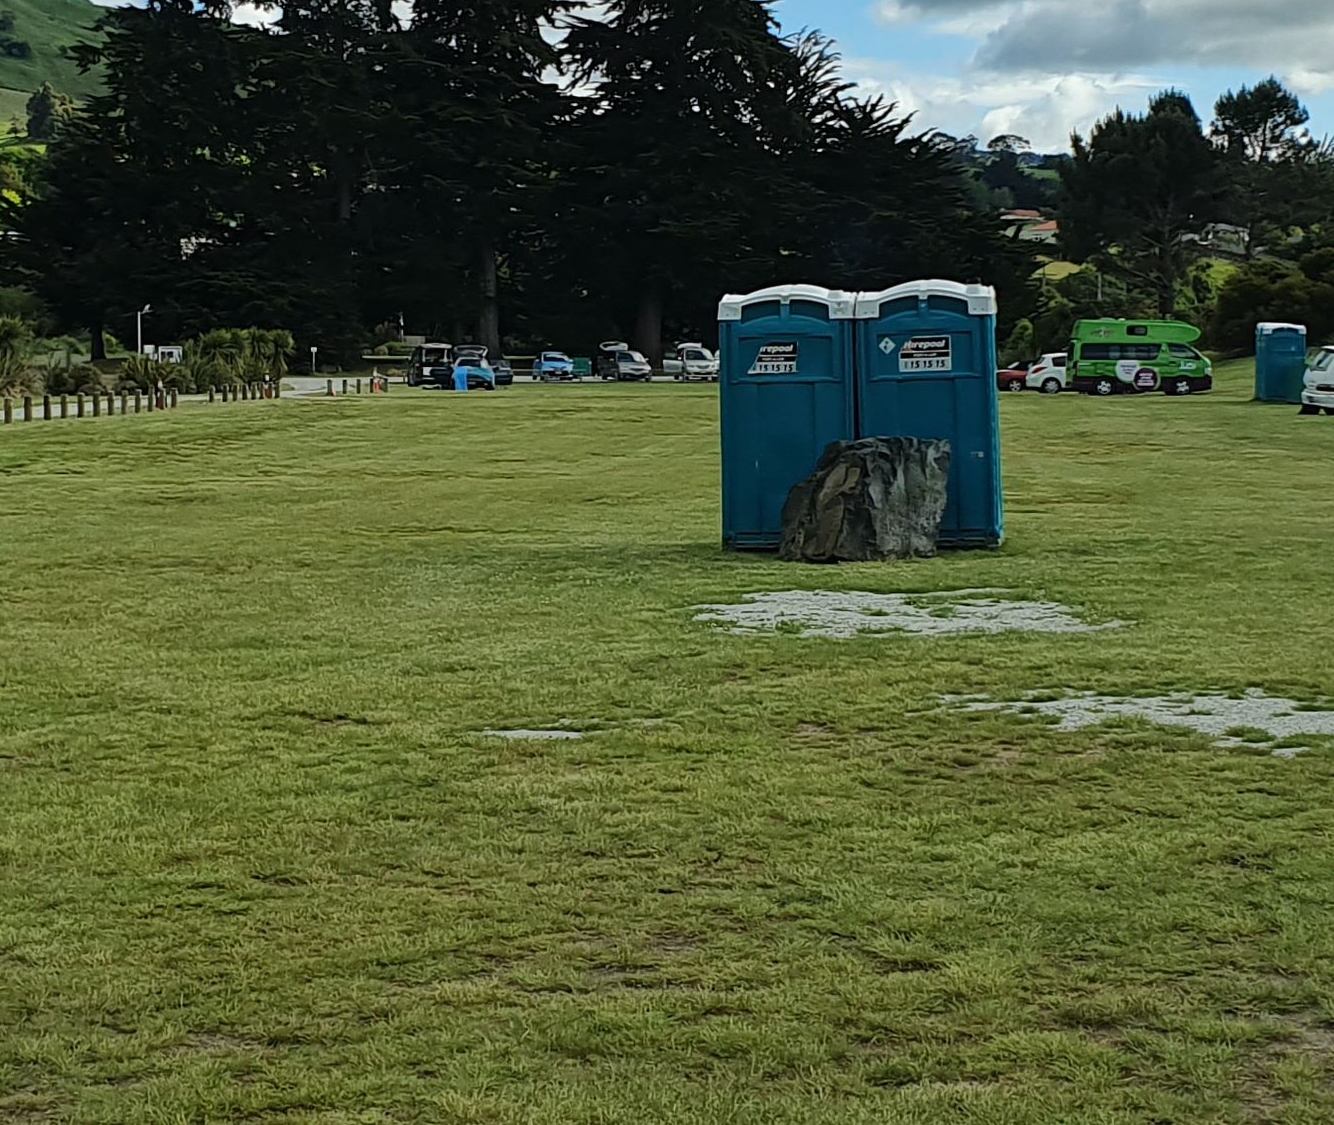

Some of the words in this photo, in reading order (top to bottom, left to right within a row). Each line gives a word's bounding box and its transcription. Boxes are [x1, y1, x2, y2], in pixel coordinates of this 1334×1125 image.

[759, 364, 768, 372] 15
[771, 364, 780, 372] 15
[784, 364, 793, 372] 15
[910, 360, 920, 369] 15
[923, 360, 933, 369] 15
[936, 359, 946, 368] 15
